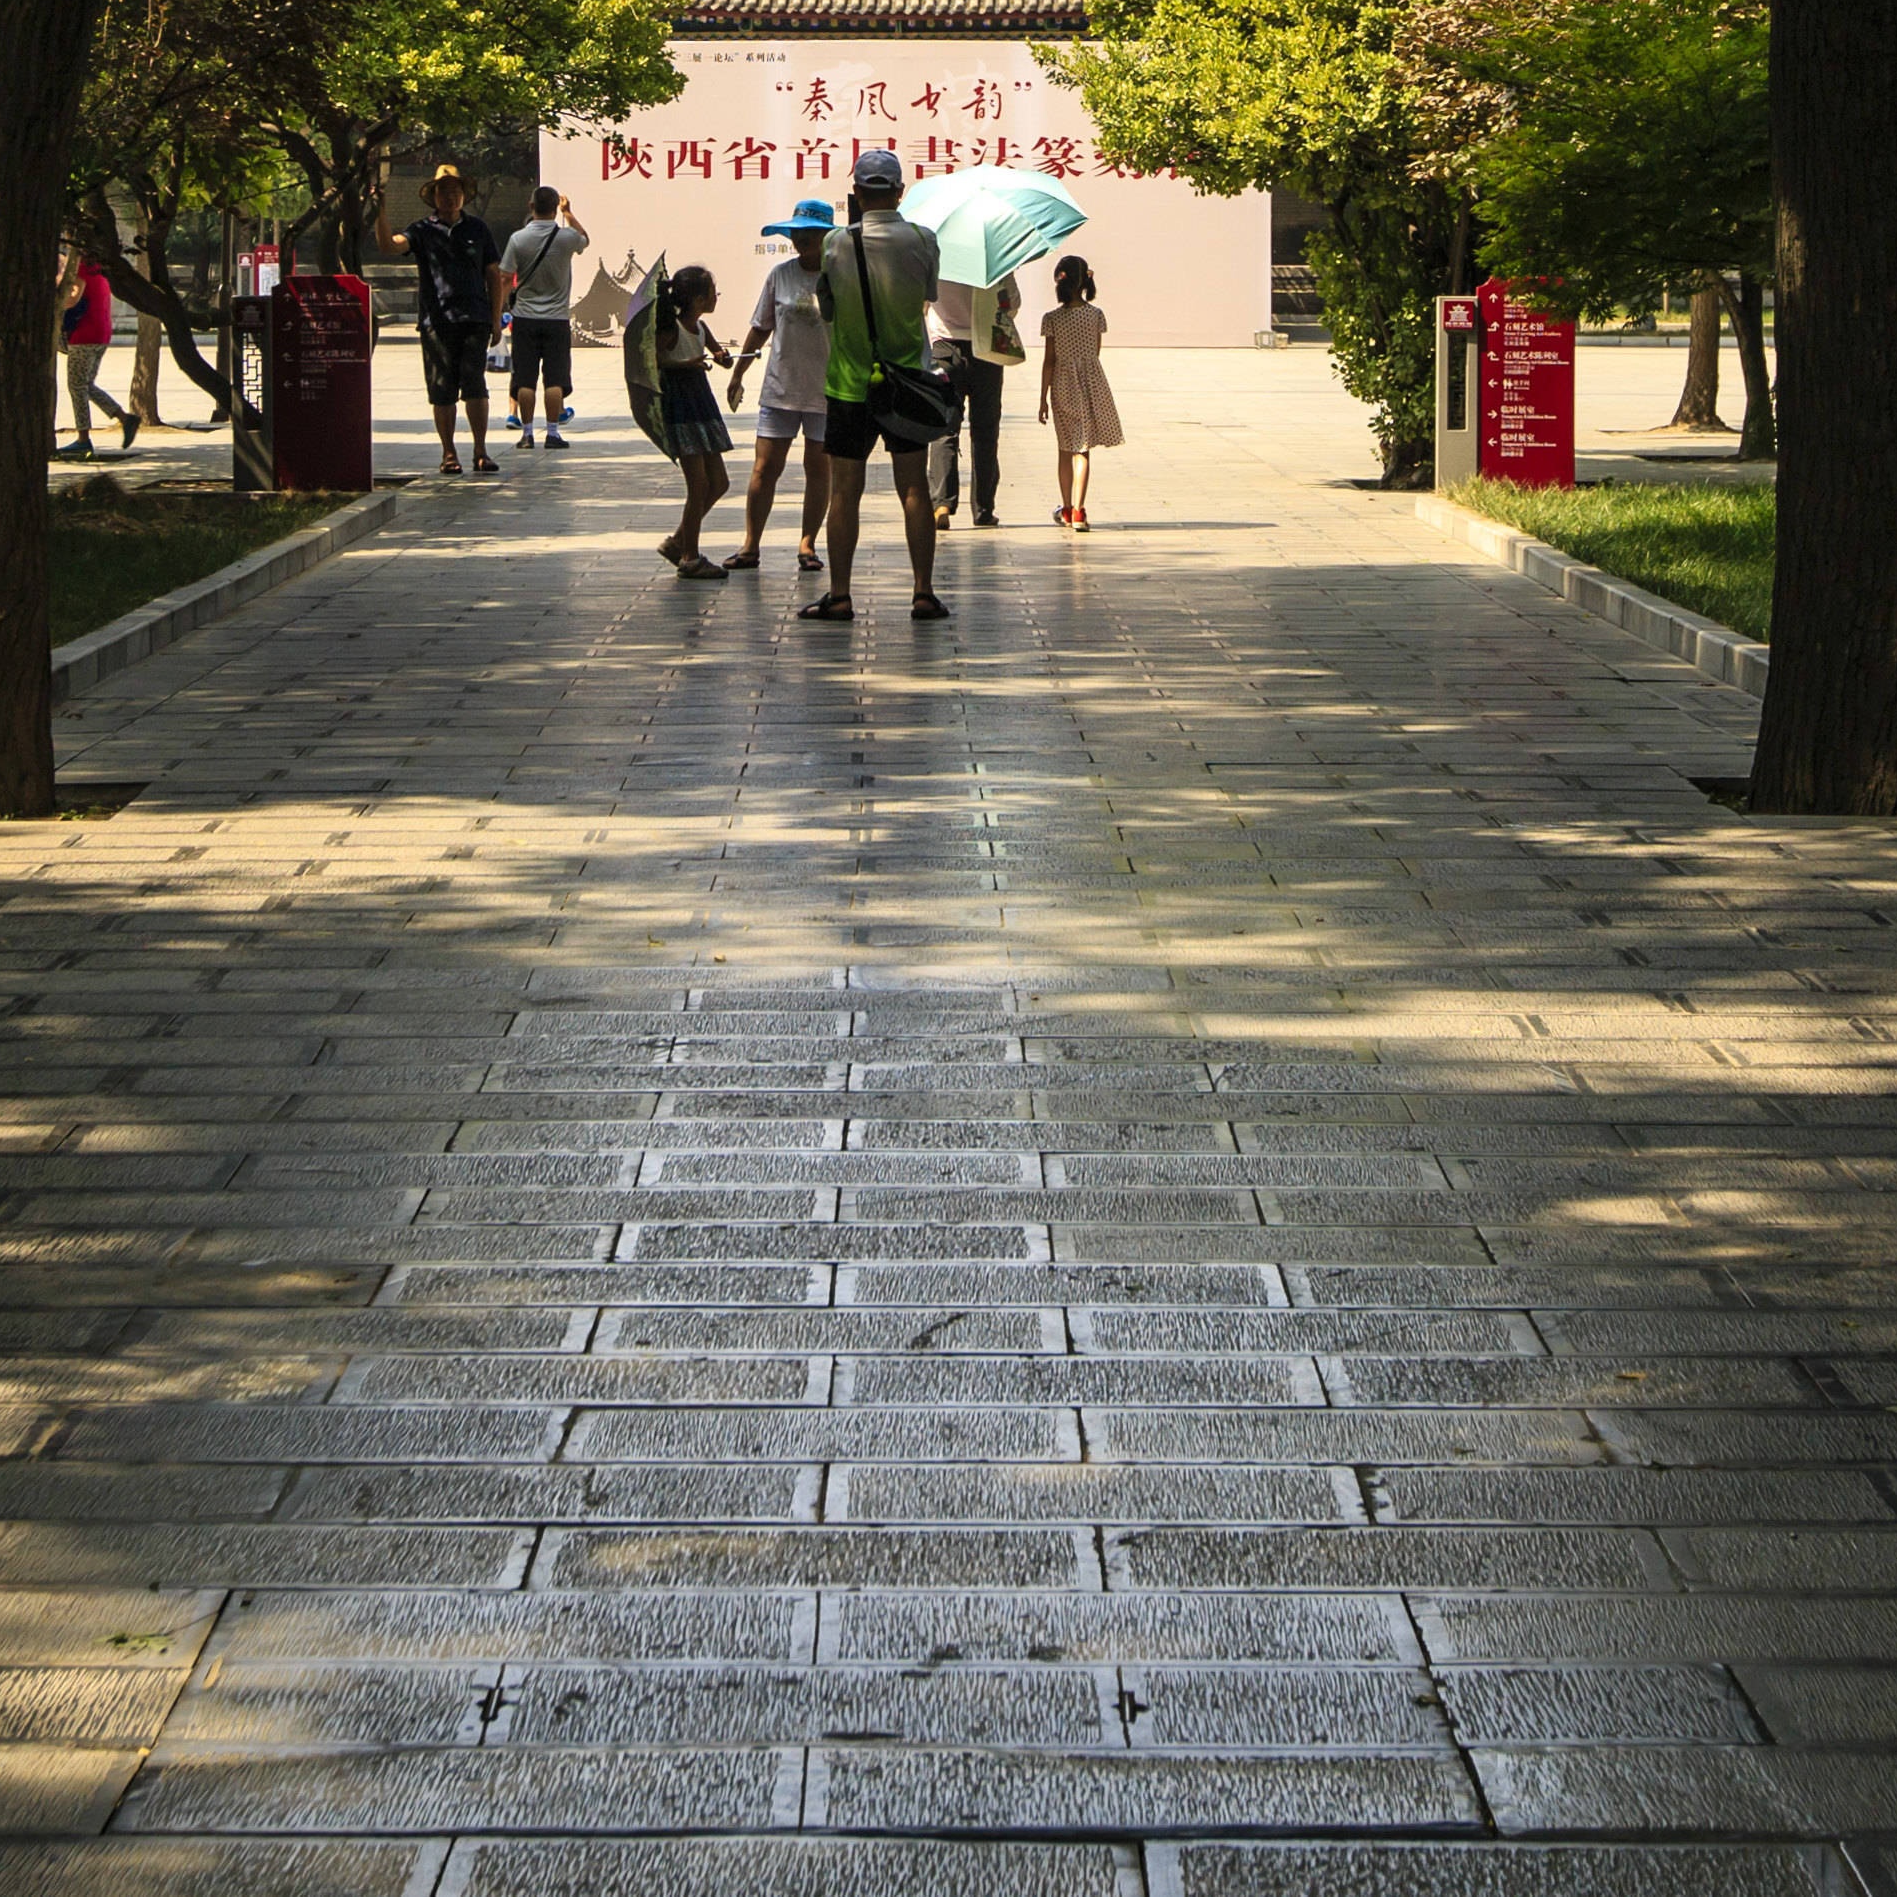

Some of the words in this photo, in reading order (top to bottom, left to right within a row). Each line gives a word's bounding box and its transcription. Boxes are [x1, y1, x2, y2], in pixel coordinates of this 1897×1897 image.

[601, 135, 1201, 181] 陝西省首書法篆
